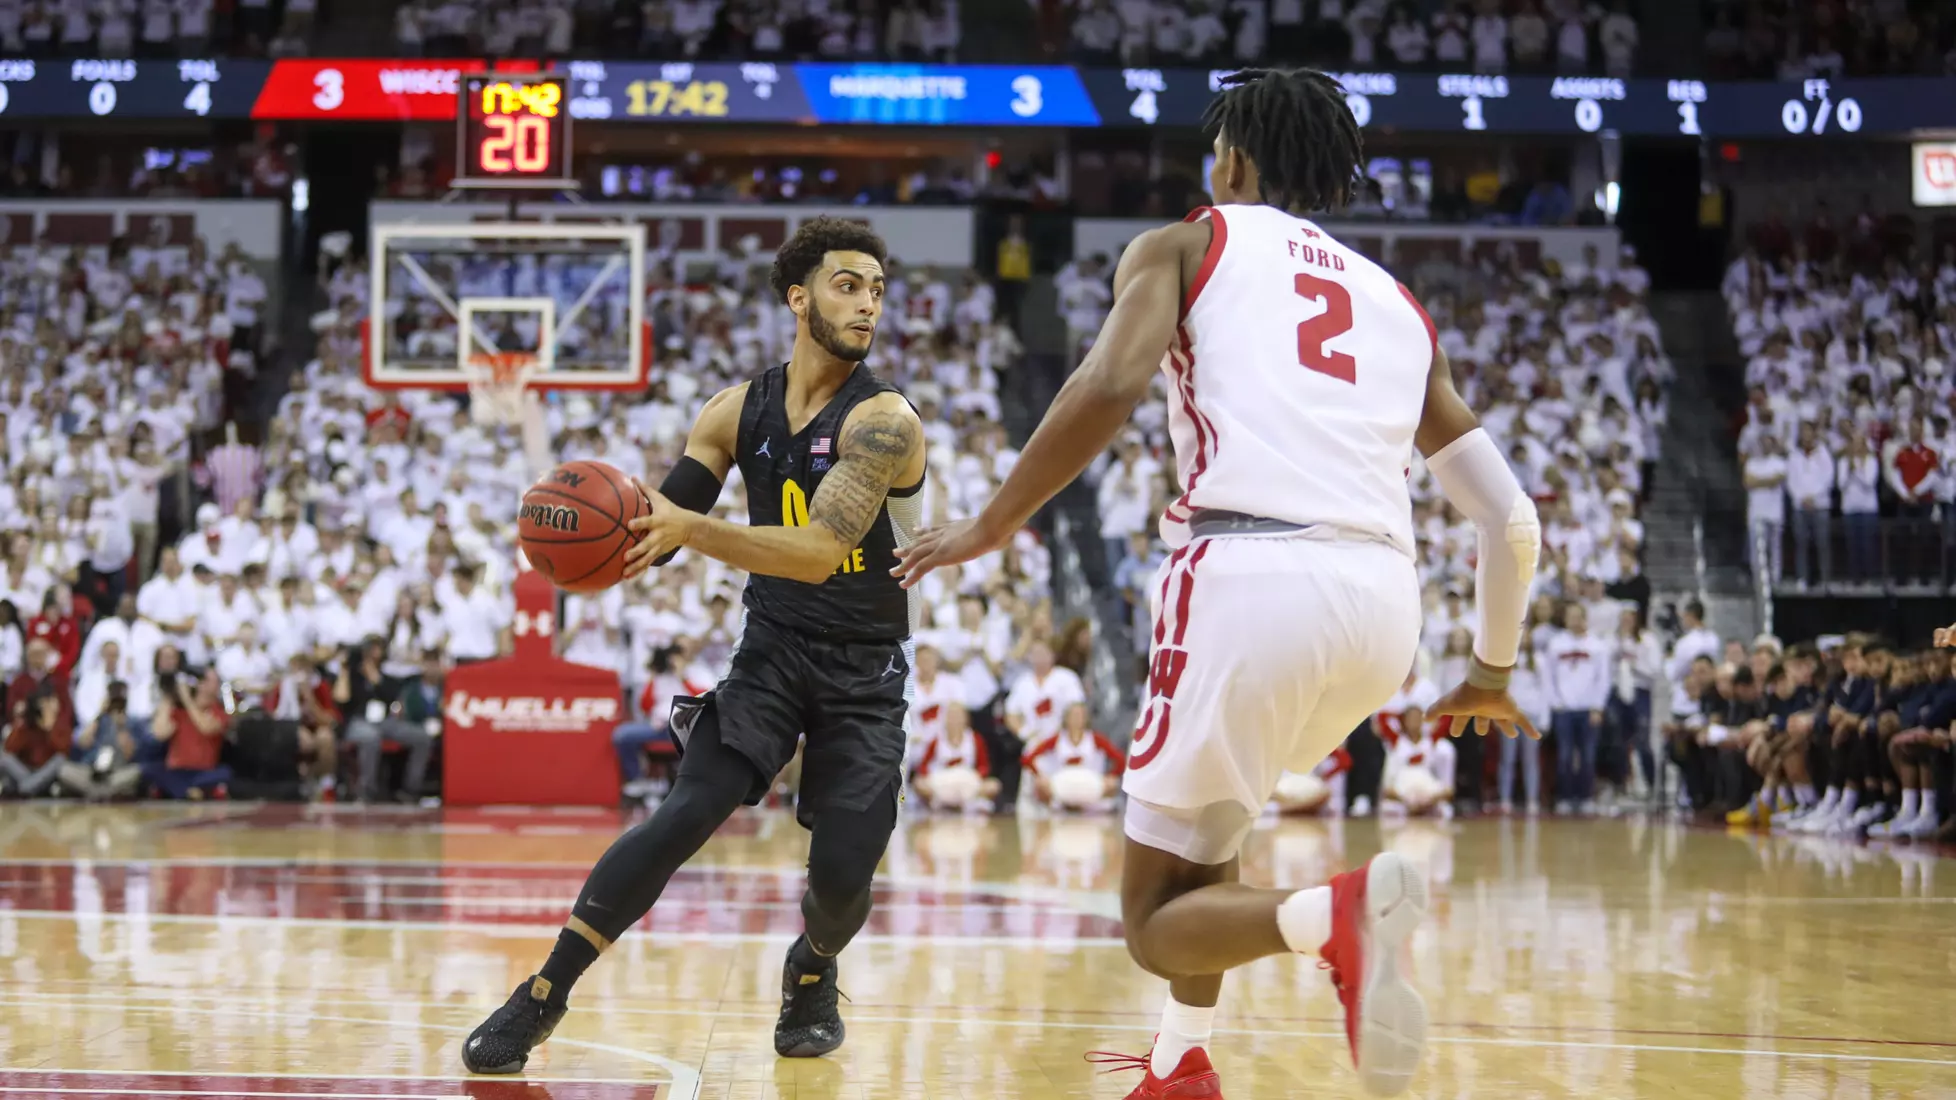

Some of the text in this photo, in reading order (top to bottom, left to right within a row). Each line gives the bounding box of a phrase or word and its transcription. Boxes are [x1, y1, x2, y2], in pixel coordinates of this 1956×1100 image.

[71, 59, 137, 82] FOULS
[1438, 75, 1509, 98] STEALS
[89, 82, 116, 115] 0
[184, 82, 212, 116] 4
[313, 69, 344, 110] 3
[626, 81, 728, 116] 17:42
[830, 75, 967, 101] MARQUETTE
[1011, 75, 1043, 117] 3
[1667, 80, 1707, 102] REB
[1130, 91, 1158, 124] 4
[1462, 96, 1486, 130] 1
[1575, 100, 1603, 132] 0
[1678, 101, 1701, 135] 1
[481, 115, 549, 172] 20
[1287, 239, 1345, 271] FORD
[1294, 273, 1356, 385] 2
[467, 696, 617, 721] MUELLER
